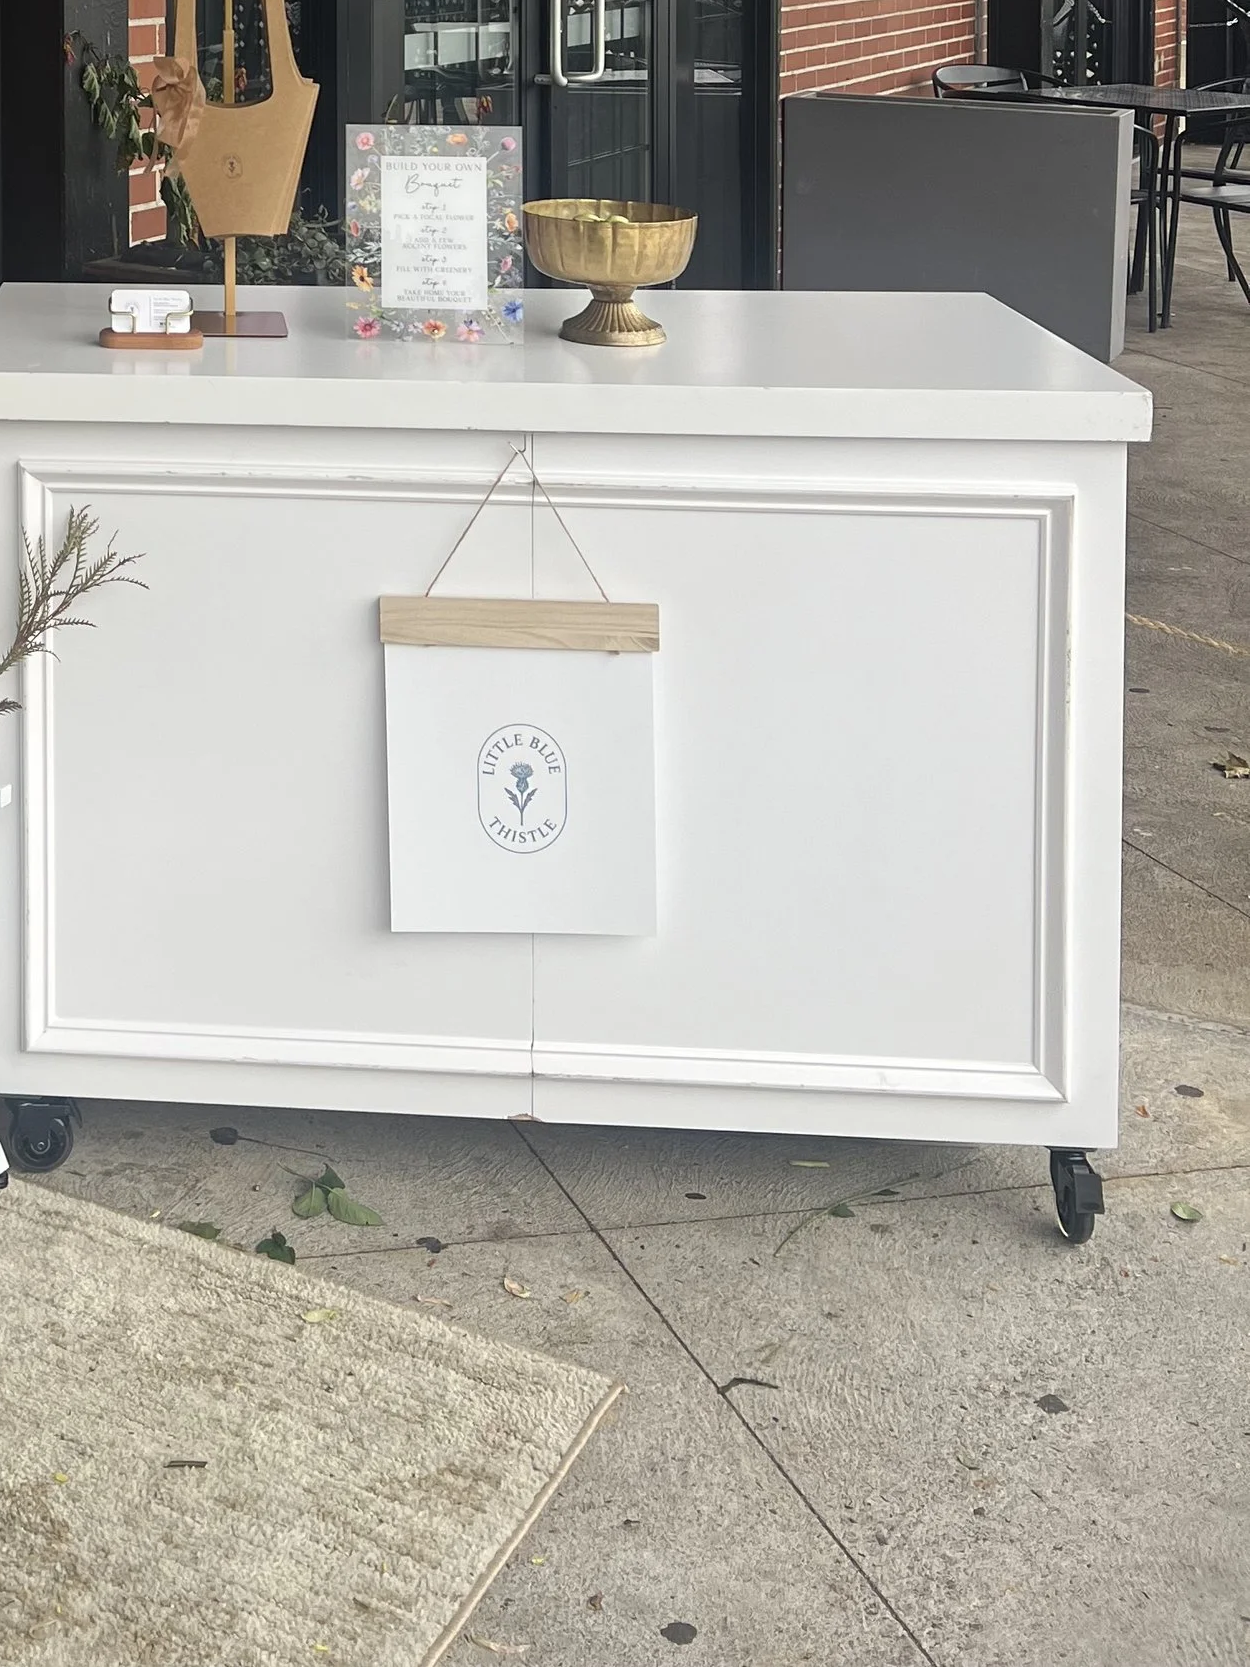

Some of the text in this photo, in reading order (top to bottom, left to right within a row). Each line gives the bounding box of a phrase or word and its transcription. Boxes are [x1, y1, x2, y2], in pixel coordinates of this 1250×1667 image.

[385, 161, 482, 172] BUILD YOUR OWN
[404, 173, 463, 197] Bouquet
[482, 733, 561, 775] LITTLE BLUE
[488, 816, 557, 844] THISTLE
